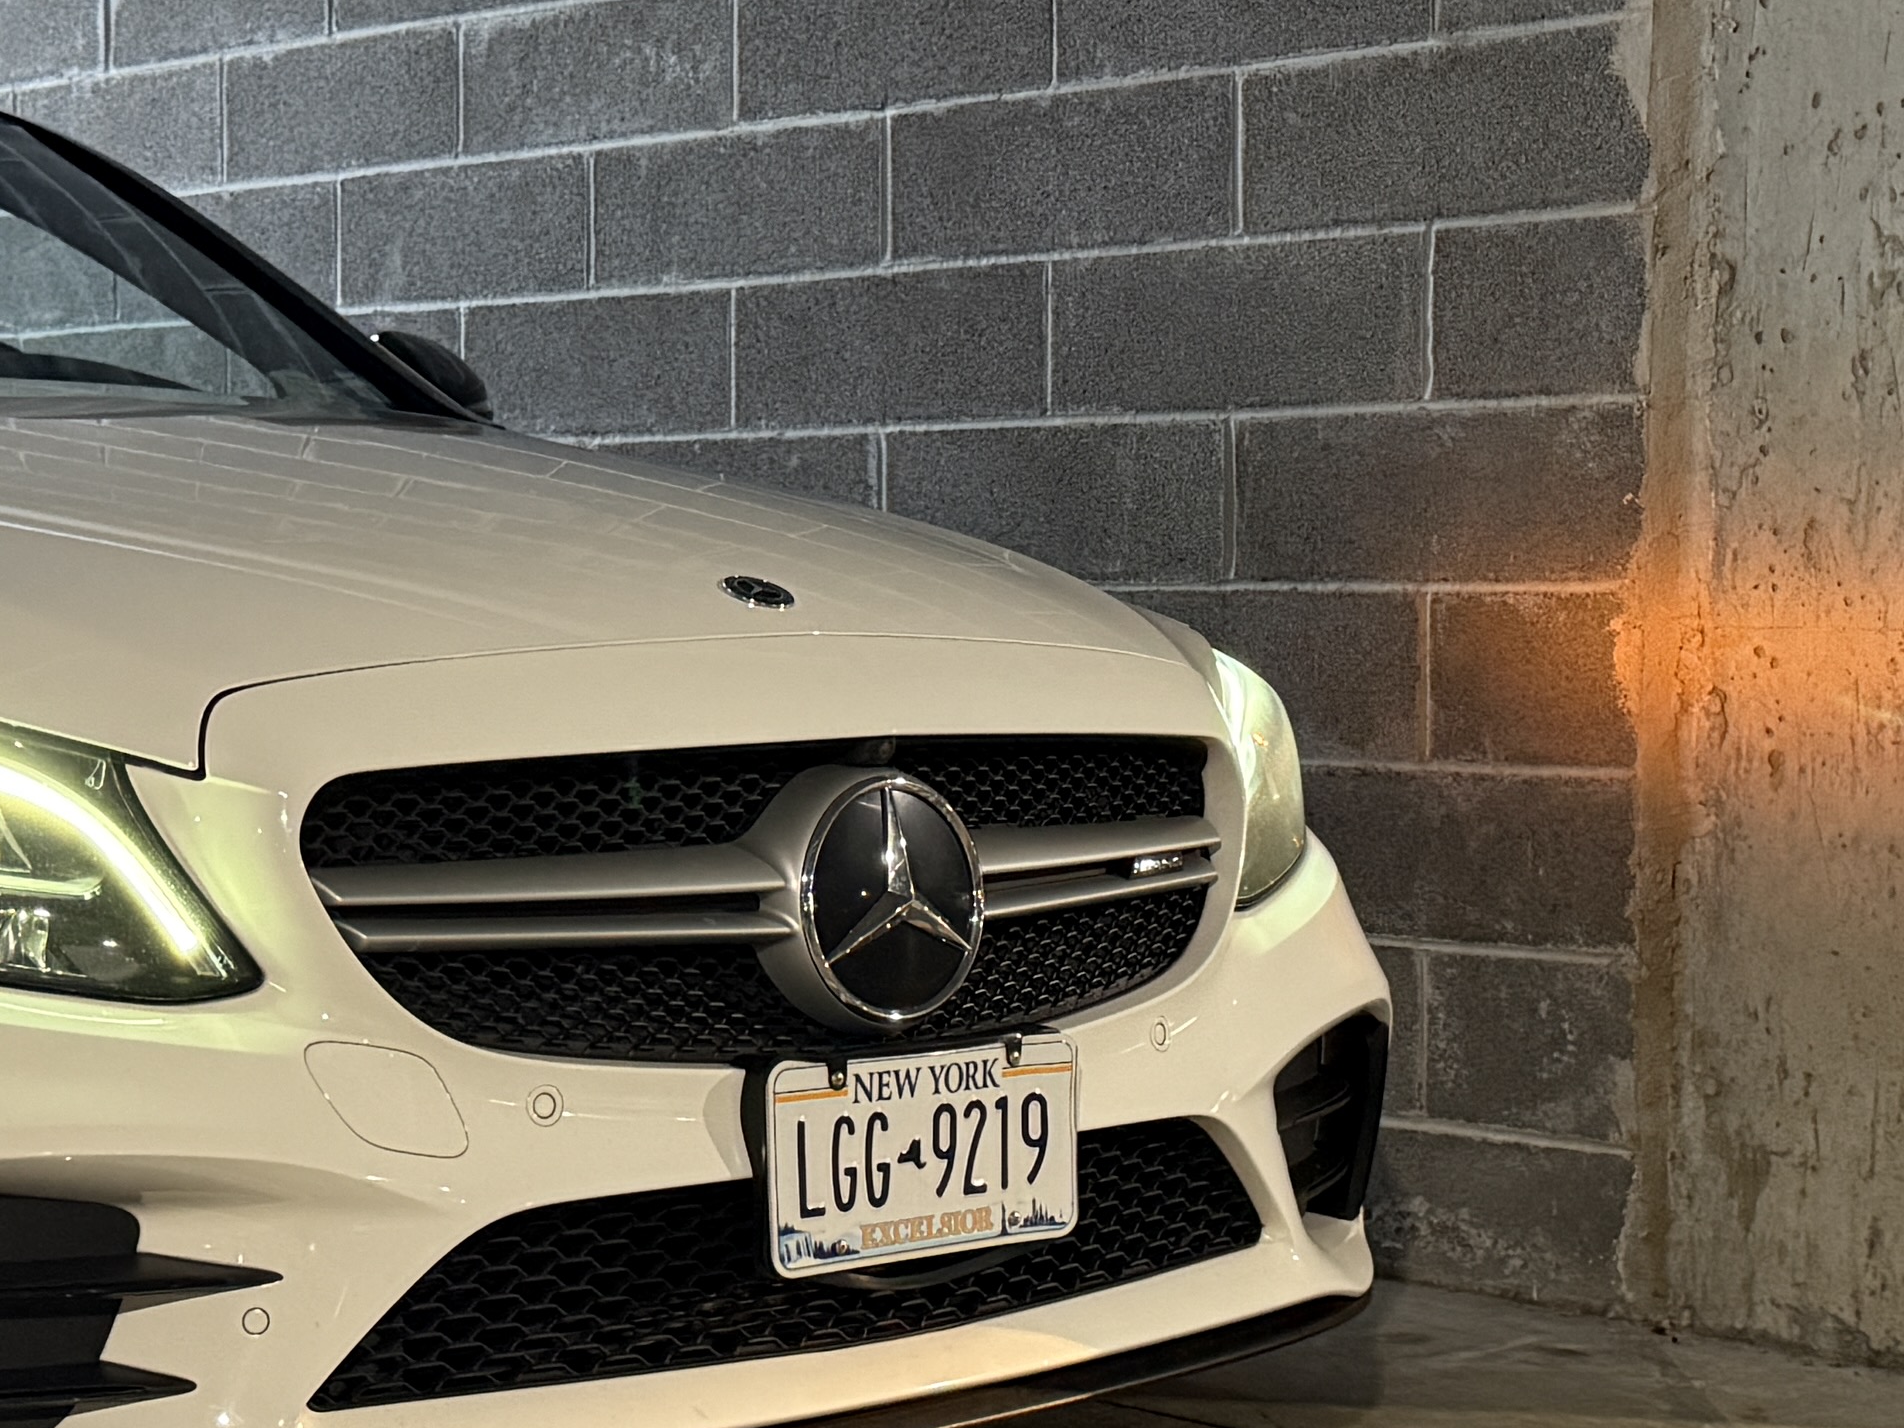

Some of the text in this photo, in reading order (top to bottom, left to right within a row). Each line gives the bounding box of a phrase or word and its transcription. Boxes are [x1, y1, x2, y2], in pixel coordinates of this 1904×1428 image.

[852, 1057, 1001, 1104] NEW YORK
[797, 1091, 1048, 1219] LGG 9219
[859, 1205, 994, 1250] EXCELSIOR
